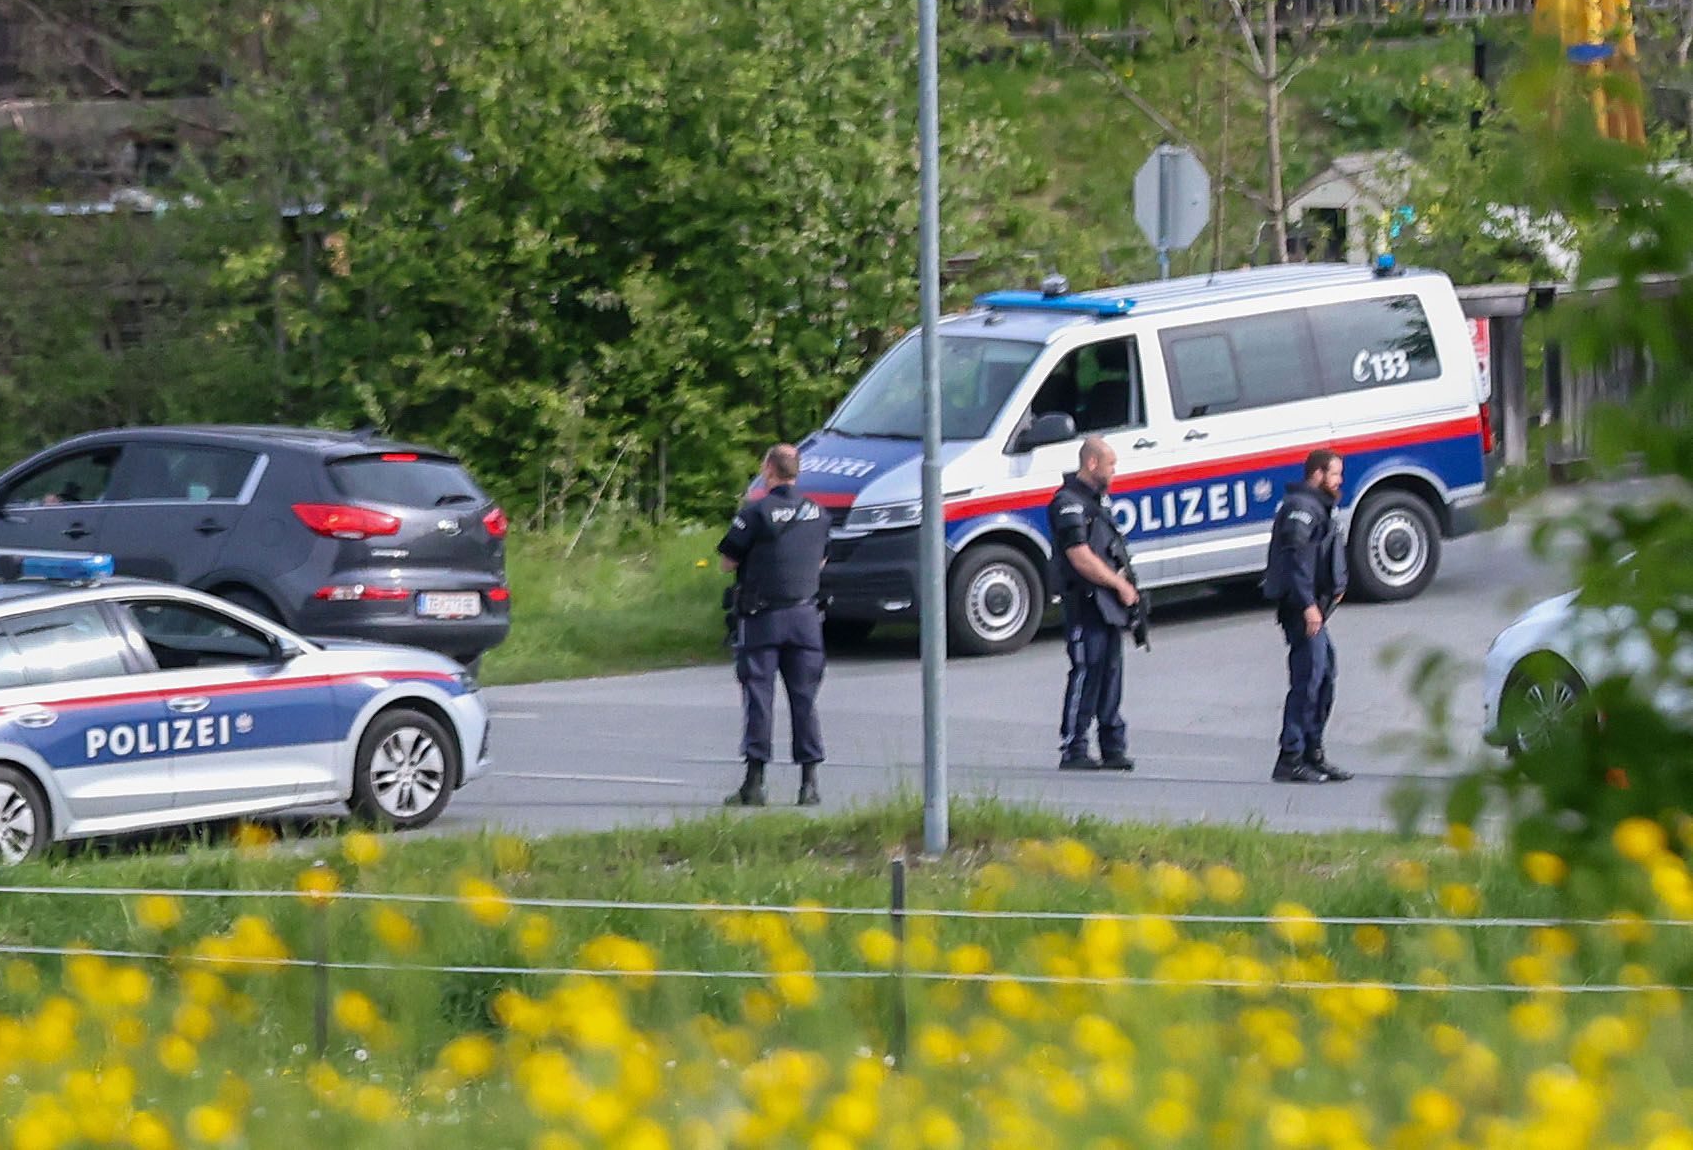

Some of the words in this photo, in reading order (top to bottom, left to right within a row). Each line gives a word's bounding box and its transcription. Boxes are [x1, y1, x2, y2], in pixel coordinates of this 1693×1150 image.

[799, 455, 876, 478] OLIZEI
[1111, 480, 1248, 536] OLIZEI
[86, 714, 231, 759] POLIZEI
